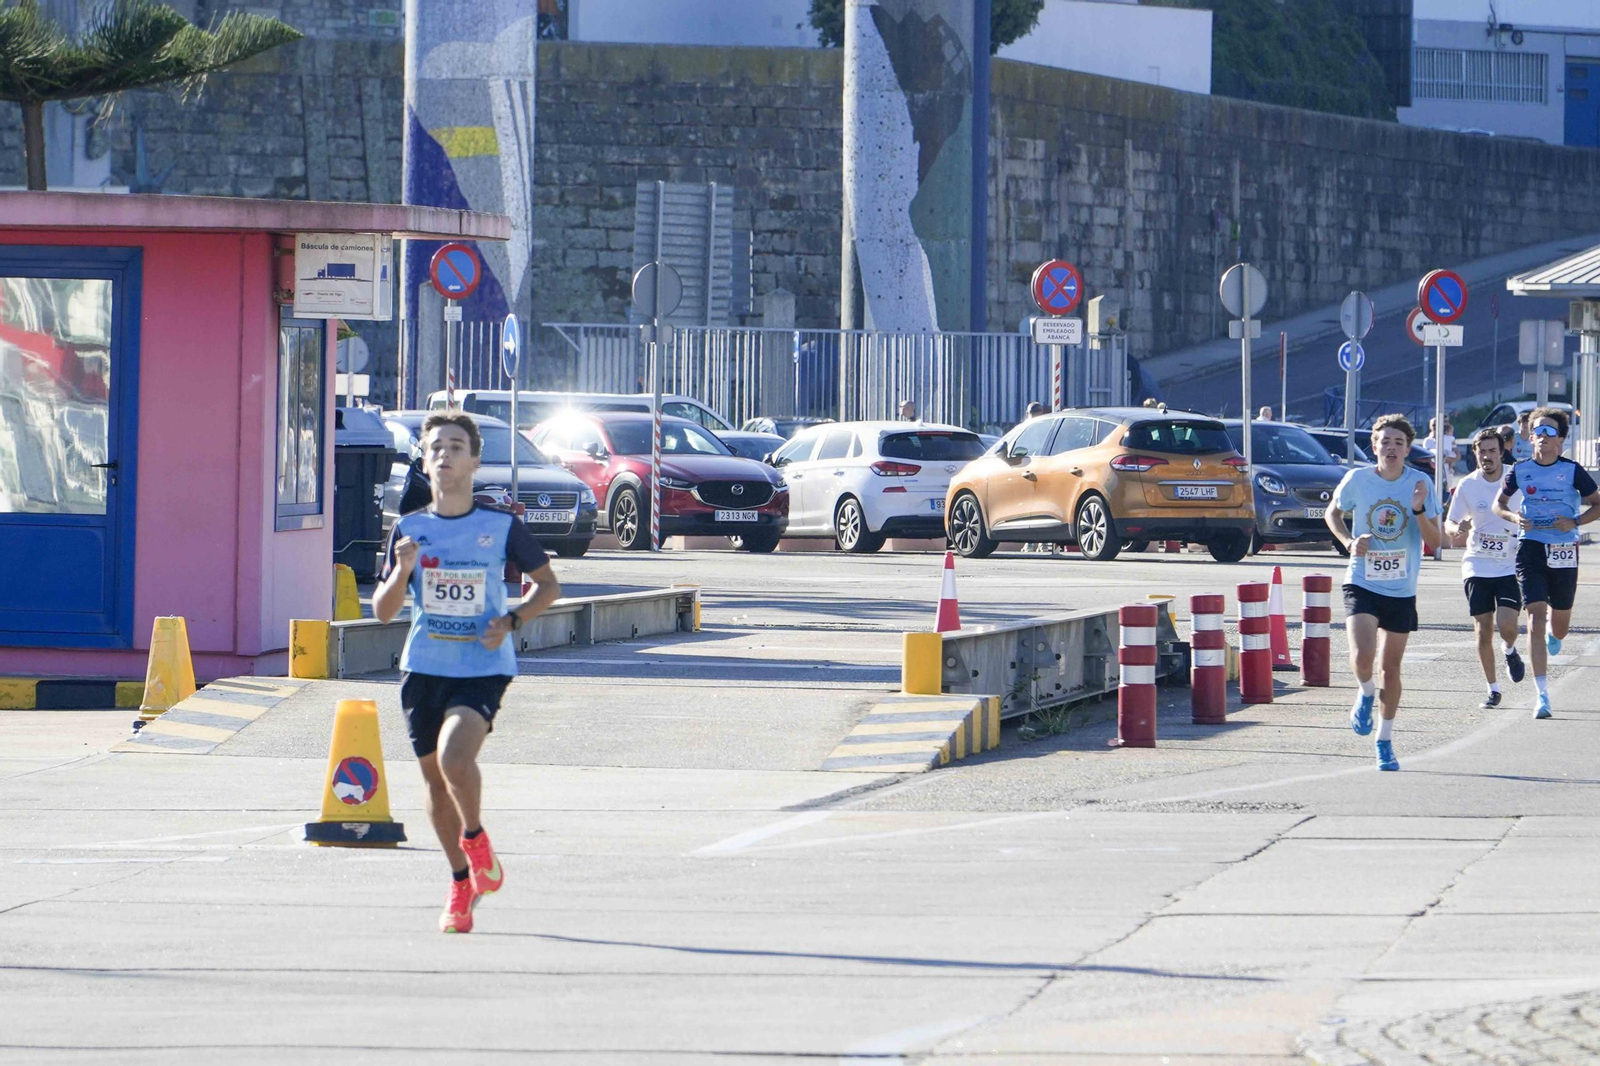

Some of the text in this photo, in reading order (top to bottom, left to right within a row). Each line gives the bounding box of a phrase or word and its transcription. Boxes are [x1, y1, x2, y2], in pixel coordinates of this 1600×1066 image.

[1180, 487, 1215, 496] 2547 LHF
[529, 512, 568, 521] 7465 FDJ
[720, 511, 756, 520] 2313 NGK
[1482, 540, 1503, 551] 523
[1552, 550, 1573, 560] 502
[1373, 559, 1400, 571] 505
[435, 584, 475, 601] 503
[428, 619, 477, 631] RODOSA
